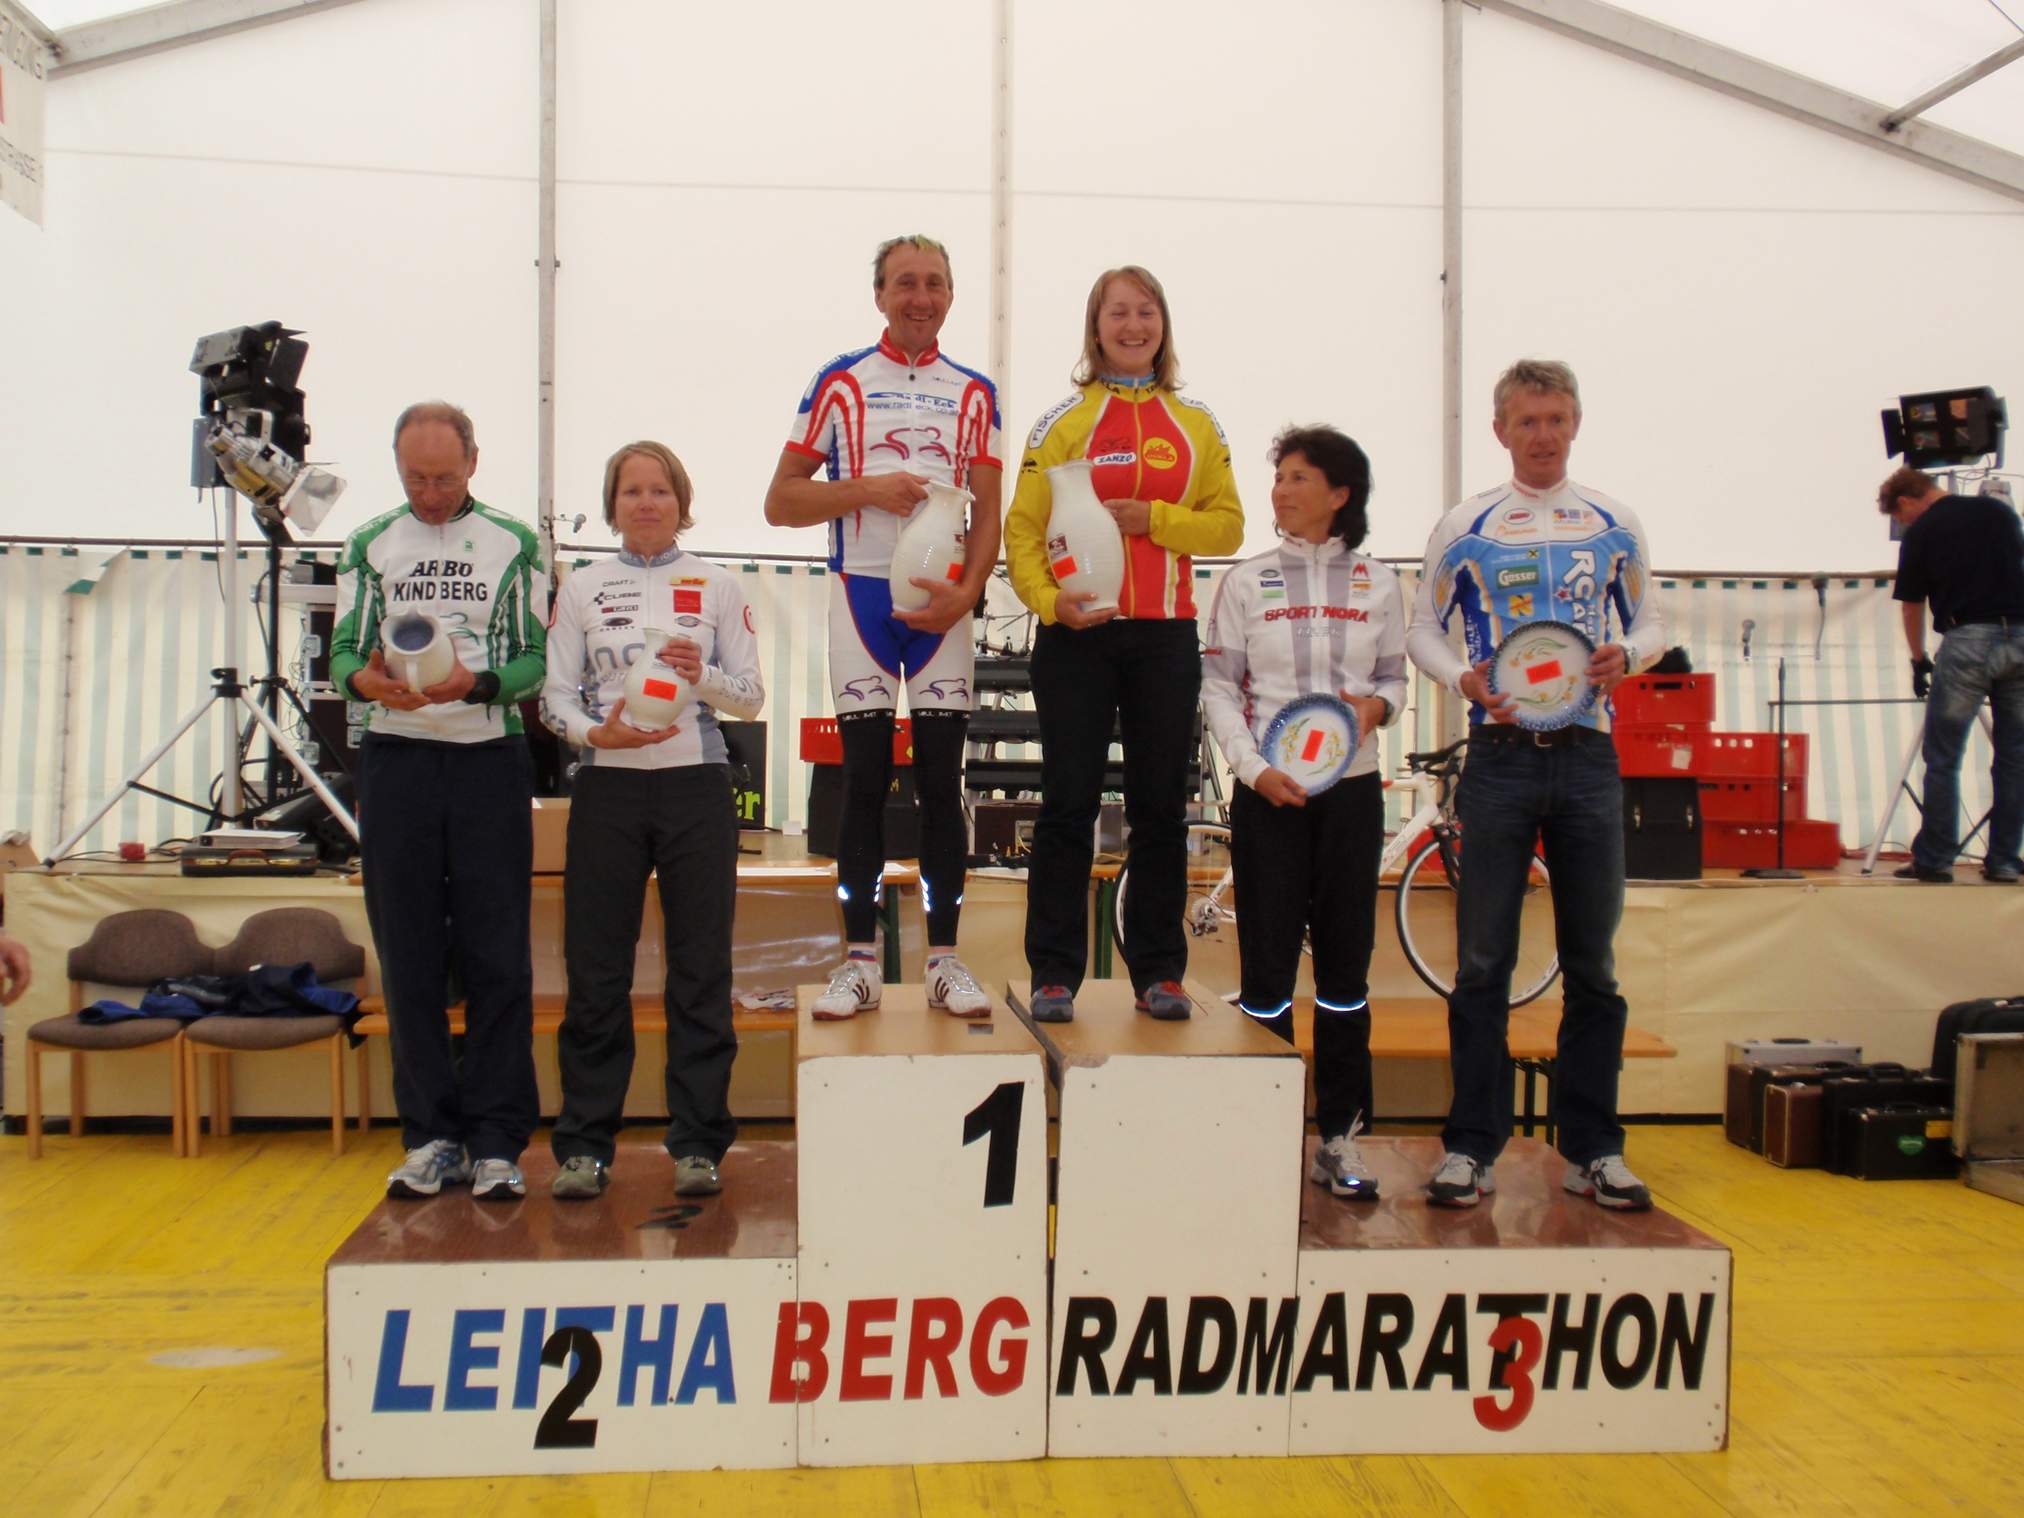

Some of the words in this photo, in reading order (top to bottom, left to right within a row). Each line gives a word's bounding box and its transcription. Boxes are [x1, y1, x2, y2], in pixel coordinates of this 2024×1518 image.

[1032, 396, 1077, 441] FISCHER
[962, 1081, 1025, 1208] 1
[372, 1302, 736, 1412] LEITHA
[769, 1296, 1030, 1403] BERG
[1056, 1291, 1715, 1397] RADMARATHON
[533, 1326, 601, 1450] 2
[1473, 1317, 1543, 1432] 3
